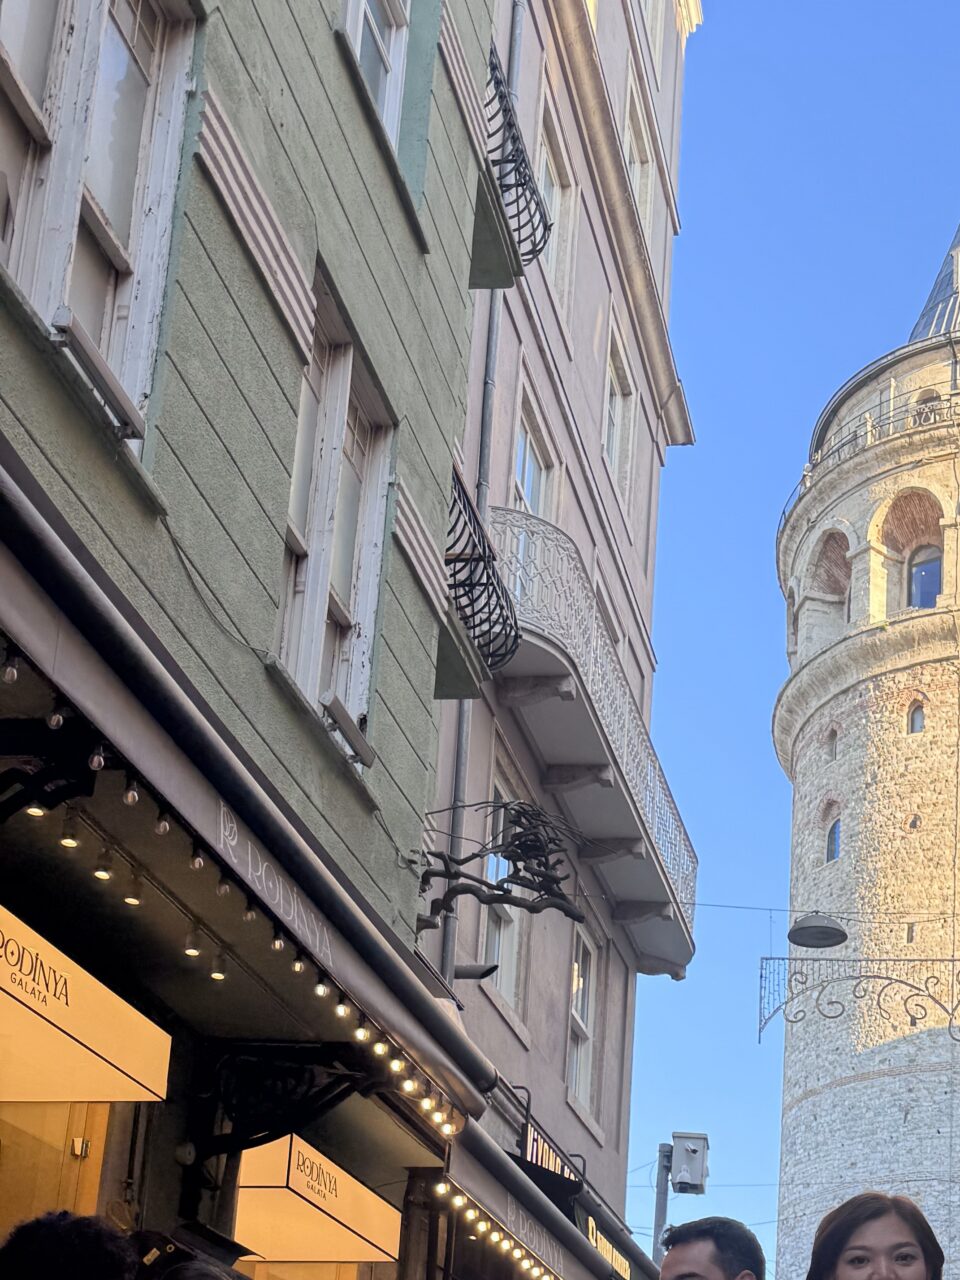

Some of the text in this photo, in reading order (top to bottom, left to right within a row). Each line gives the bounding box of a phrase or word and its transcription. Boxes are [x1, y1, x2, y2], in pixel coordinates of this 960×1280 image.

[10, 972, 48, 1007] GALATA
[296, 1150, 338, 1198] RODİNYA
[306, 1180, 327, 1201] GALATA
